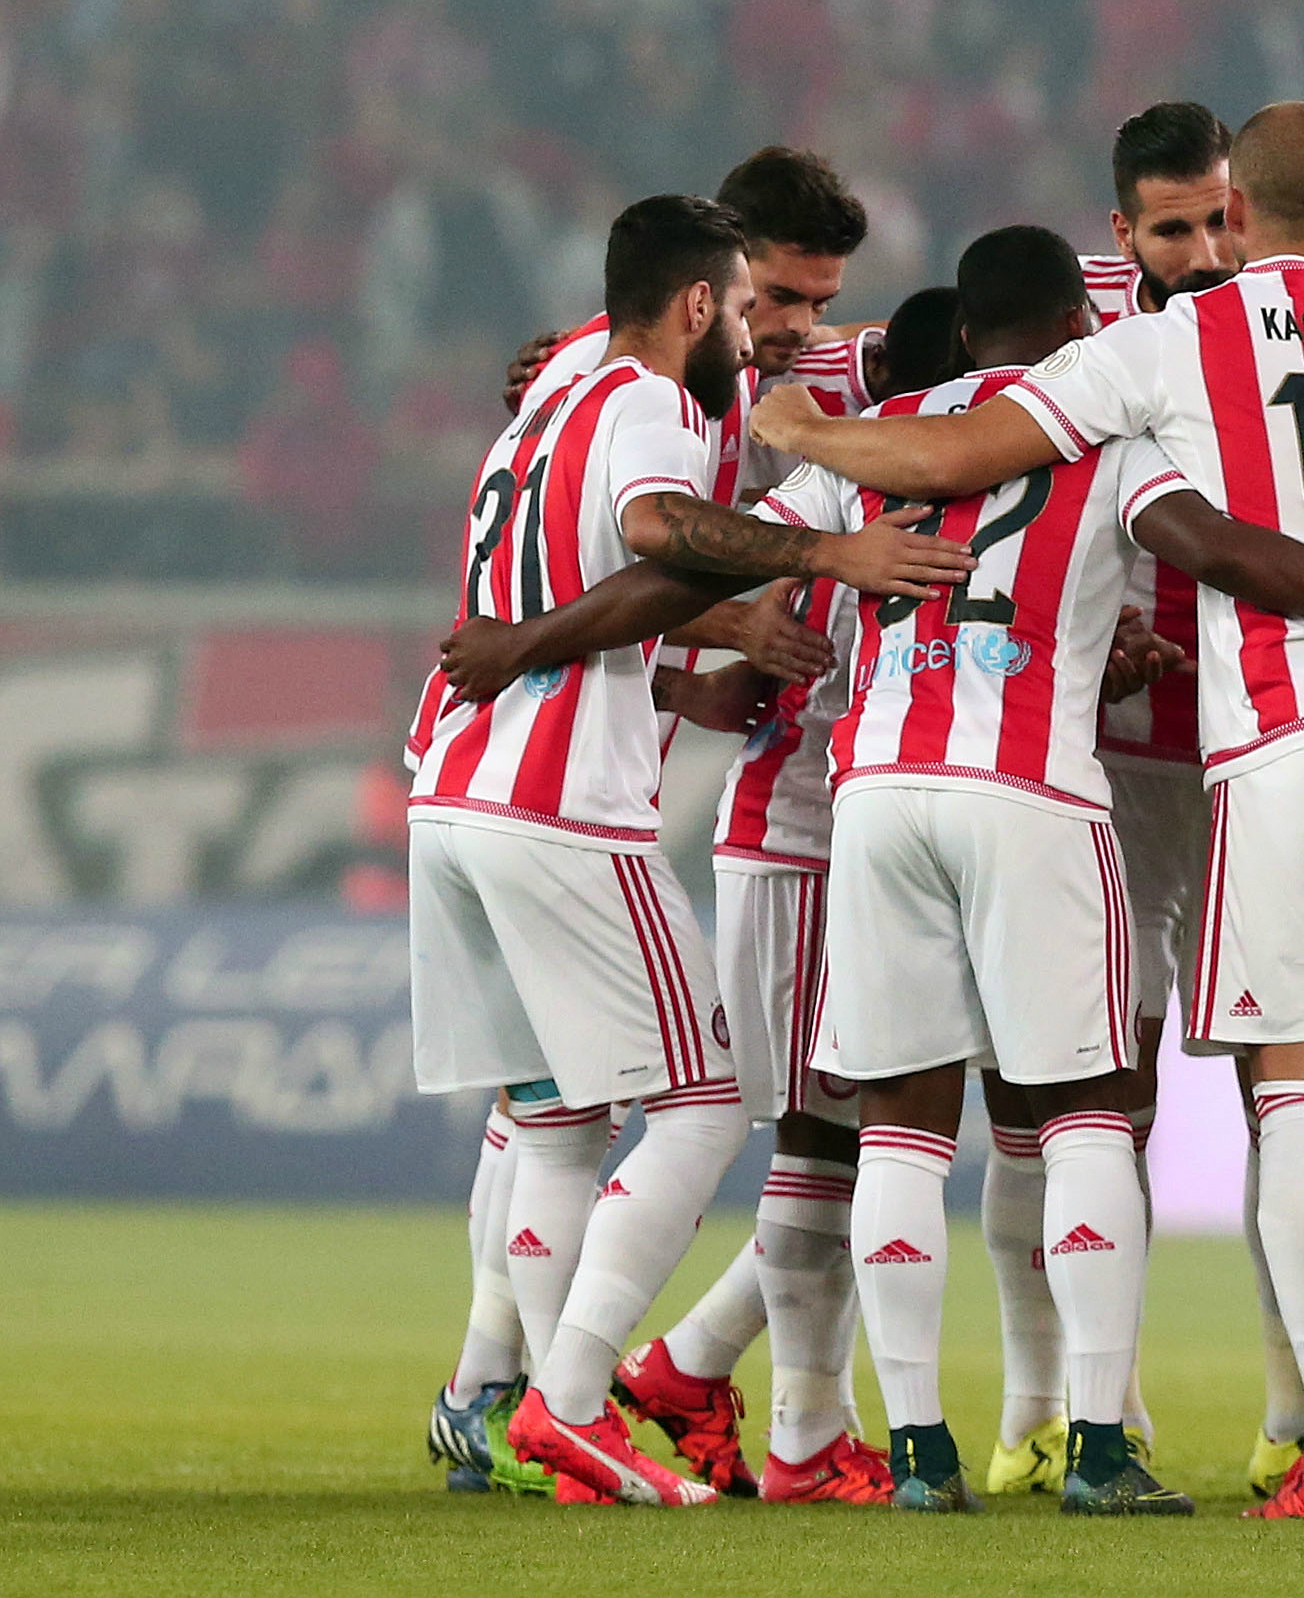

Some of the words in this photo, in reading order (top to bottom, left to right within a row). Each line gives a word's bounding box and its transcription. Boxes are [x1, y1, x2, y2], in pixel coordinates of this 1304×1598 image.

[468, 454, 549, 618] 21
[857, 627, 972, 692] unicef
[864, 1251, 932, 1264] adidas
[1050, 1239, 1116, 1256] adidas
